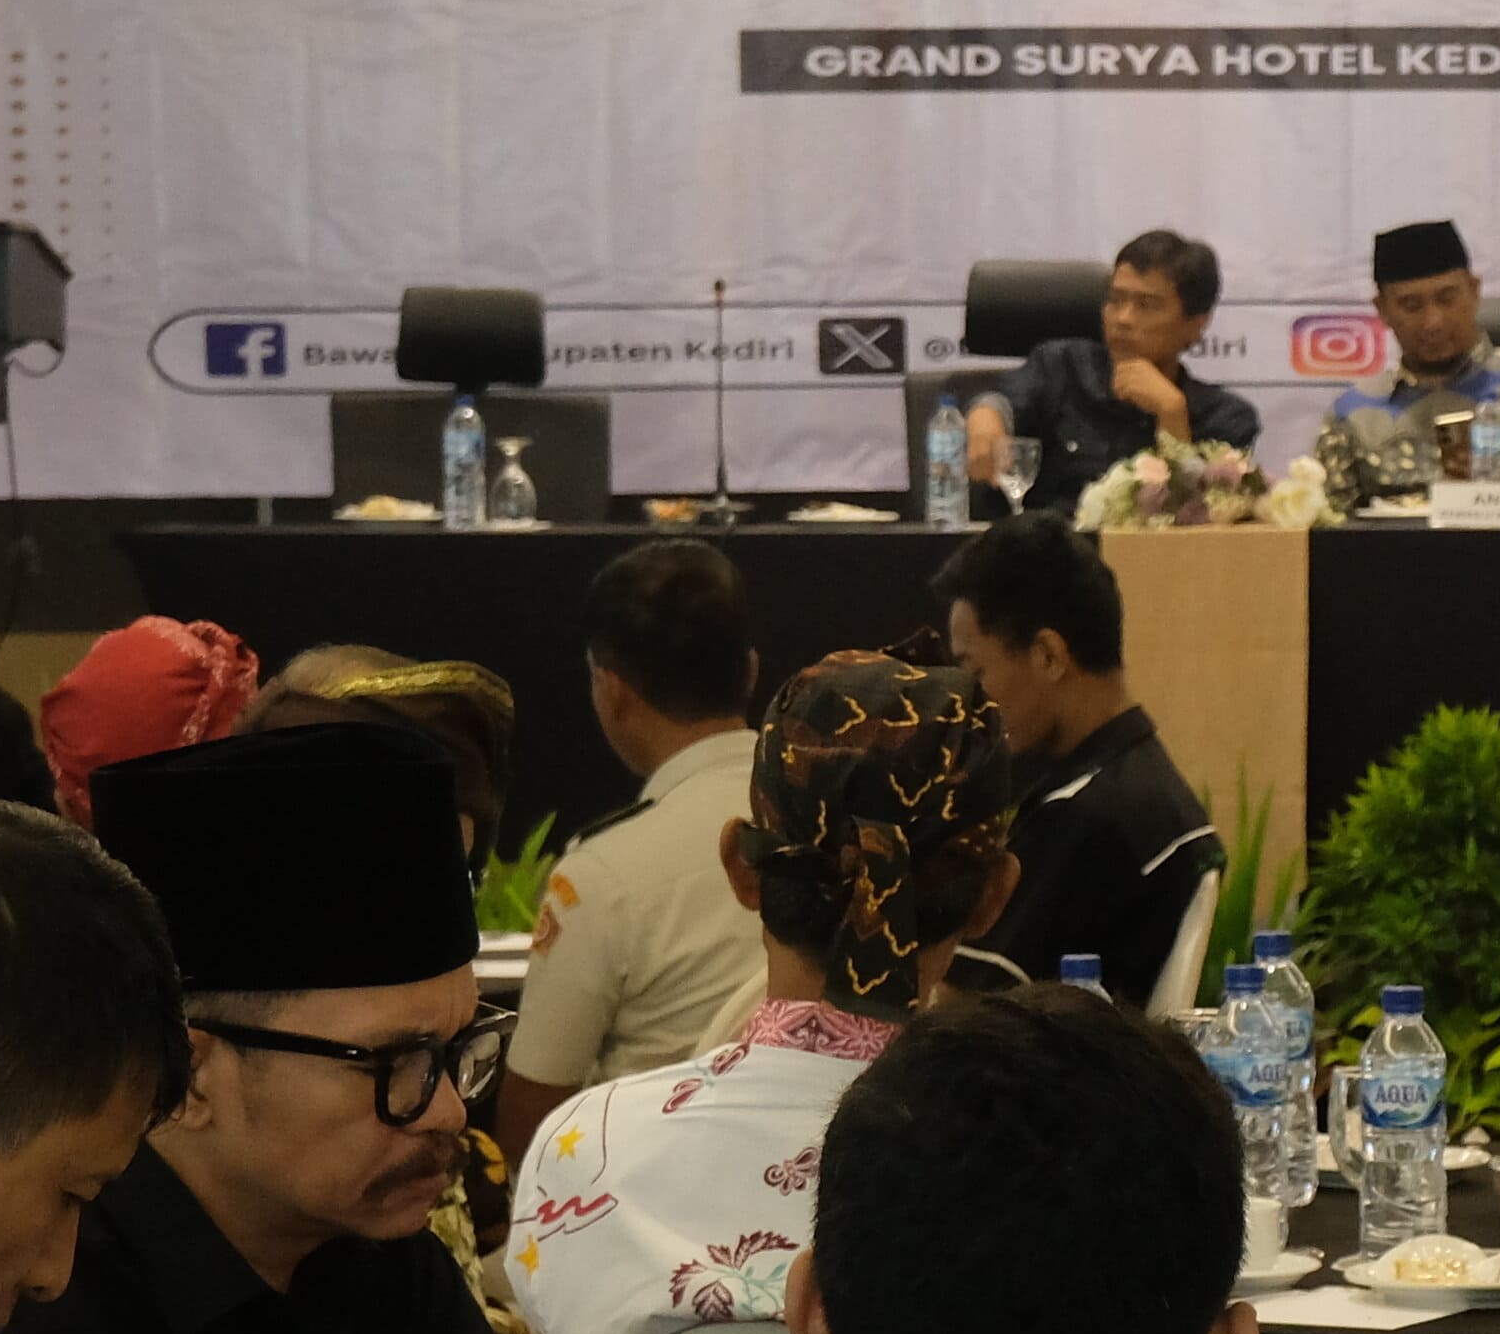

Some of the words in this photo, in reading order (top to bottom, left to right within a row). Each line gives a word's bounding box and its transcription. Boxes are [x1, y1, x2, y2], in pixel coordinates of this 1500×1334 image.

[804, 43, 1002, 78] GRAND
[1013, 43, 1200, 76] SURYA
[1211, 43, 1387, 76] HOTEL
[303, 343, 397, 366] Bawa
[685, 336, 794, 362] Kediri
[1374, 1084, 1427, 1105] AQUA
